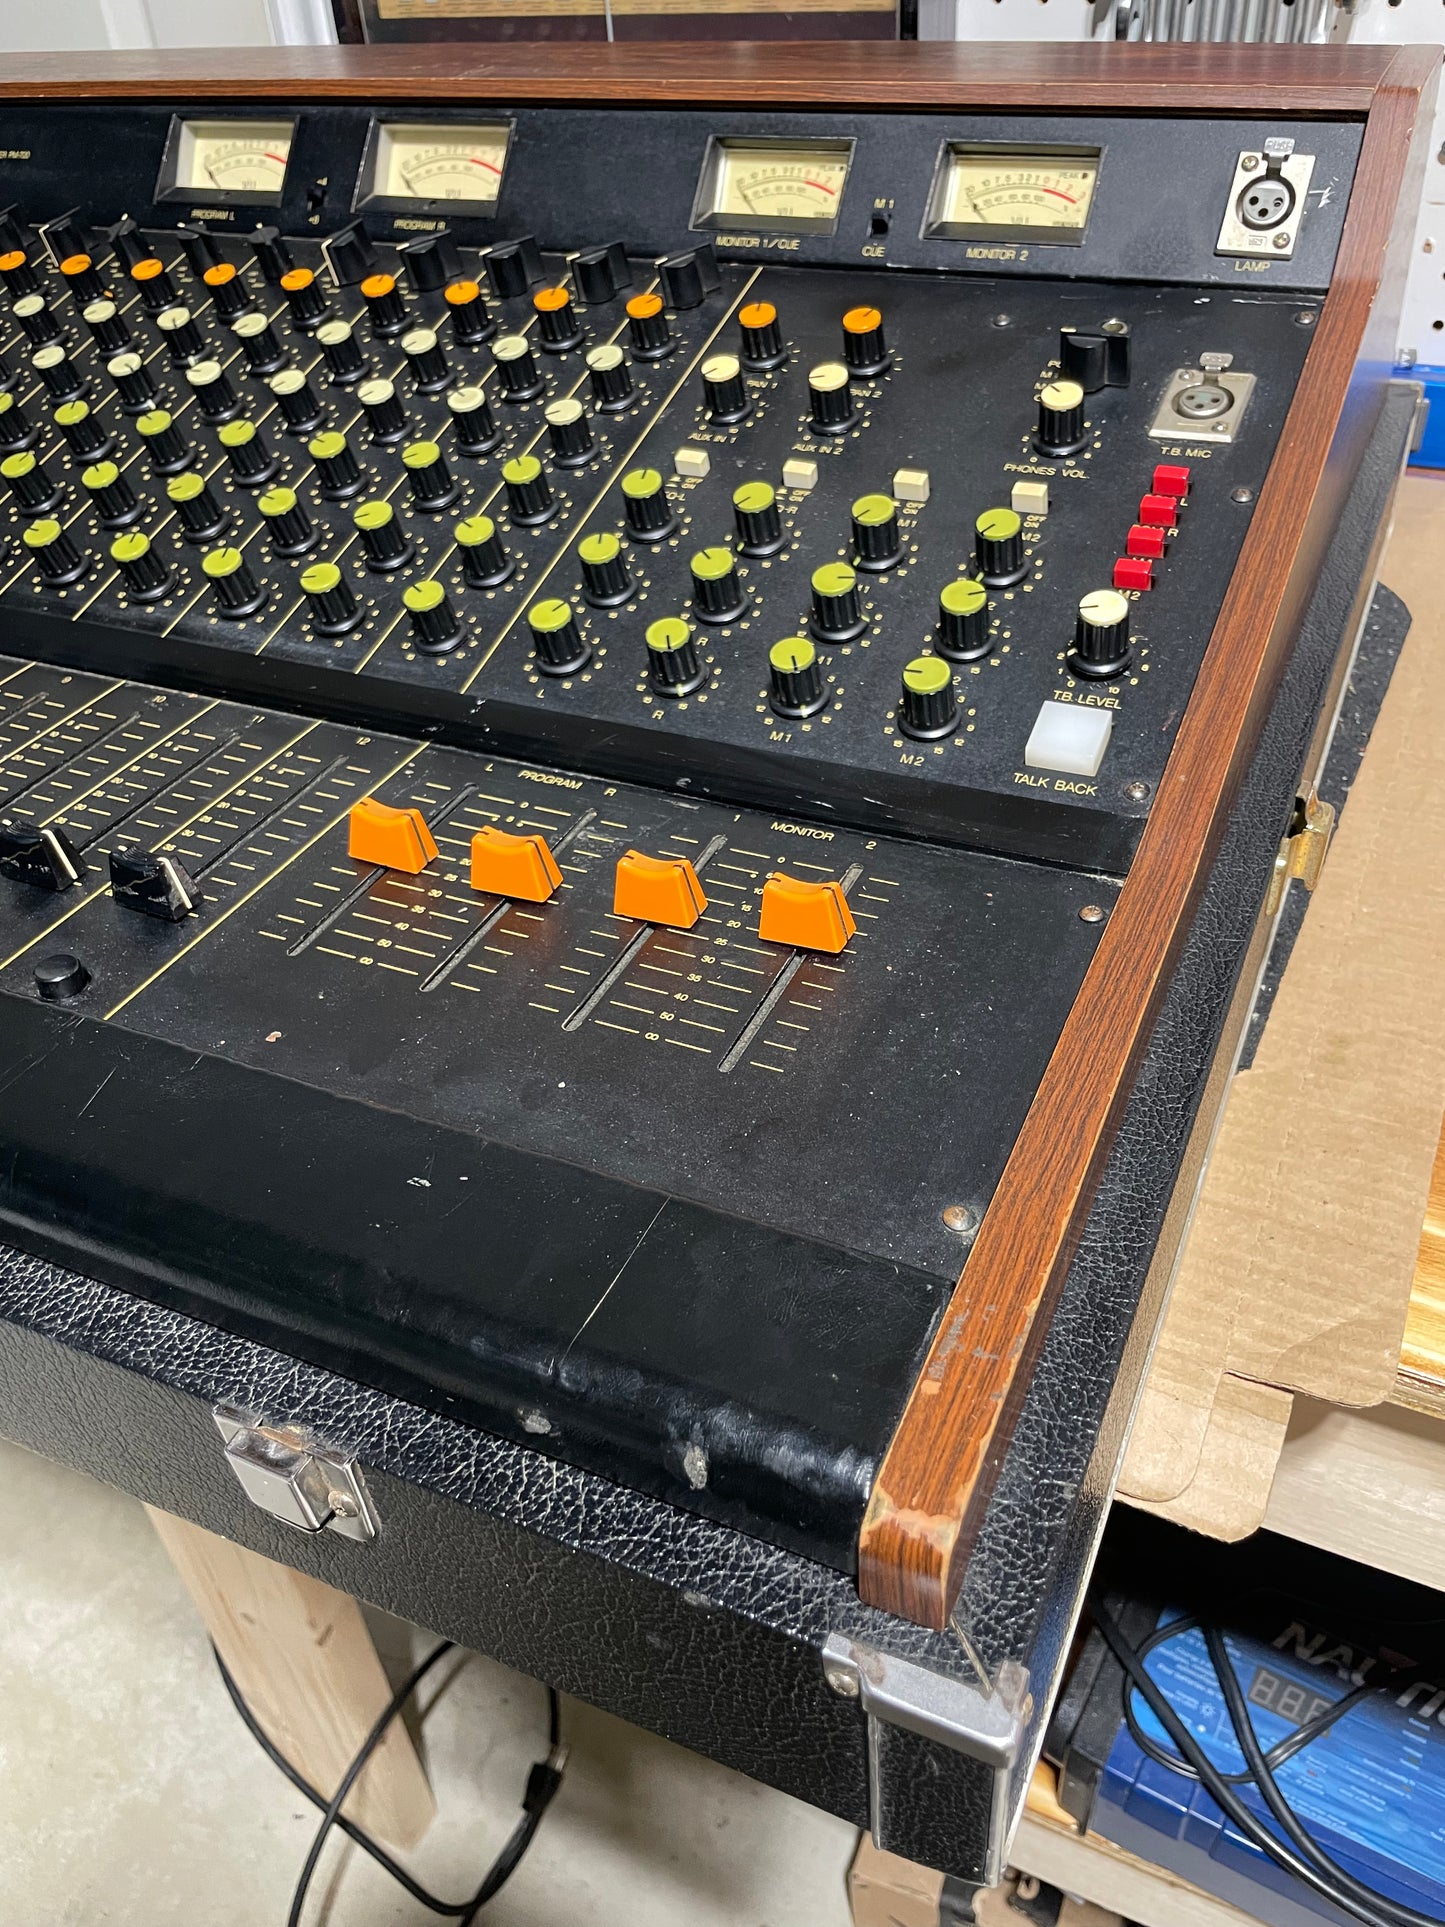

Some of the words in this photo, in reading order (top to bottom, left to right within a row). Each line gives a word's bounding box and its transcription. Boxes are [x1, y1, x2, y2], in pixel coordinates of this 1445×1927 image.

[716, 236, 760, 247] MONITOR
[861, 246, 886, 257] CUE
[965, 248, 1016, 260] MONITOR
[1019, 250, 1029, 261] 2
[1234, 261, 1270, 272] LAMP
[688, 432, 711, 442] AUX
[713, 435, 727, 443] IN
[792, 443, 817, 452] AUX
[819, 446, 833, 454] IN
[833, 447, 843, 455] 2
[1185, 448, 1212, 459] MIC
[1003, 463, 1056, 476] PHONES
[1180, 498, 1188, 506] L
[1167, 528, 1179, 537] R
[584, 619, 592, 628] L
[696, 637, 709, 646] R
[1056, 652, 1065, 660] 2
[1141, 663, 1150, 671] 8
[1067, 680, 1076, 688] 0
[1130, 678, 1138, 686] 9
[536, 689, 545, 699] L
[1108, 686, 1120, 694] 10
[152, 695, 167, 703] 10
[1078, 692, 1122, 710] LEVEL
[652, 709, 664, 720] R
[883, 726, 894, 734] 12
[356, 737, 371, 745] 12
[770, 731, 792, 743] M1
[954, 738, 964, 746] 12
[900, 753, 925, 766] M2
[518, 769, 583, 790] PROGRAM
[1013, 772, 1048, 788] TALK
[1054, 780, 1098, 796] BACK
[604, 787, 617, 796] R
[733, 814, 741, 822] 1
[771, 821, 835, 842] MONITOR
[865, 841, 877, 850] 2
[777, 856, 786, 864] 0
[443, 874, 458, 882] 25
[427, 890, 443, 898] 30
[753, 887, 764, 895] 10
[411, 905, 426, 913] 35
[394, 922, 410, 930] 40
[726, 920, 742, 928] 20
[713, 938, 728, 946] 25
[700, 956, 716, 964] 30
[686, 974, 702, 982] 35
[673, 993, 689, 1002] 40
[659, 1012, 675, 1021] 50
